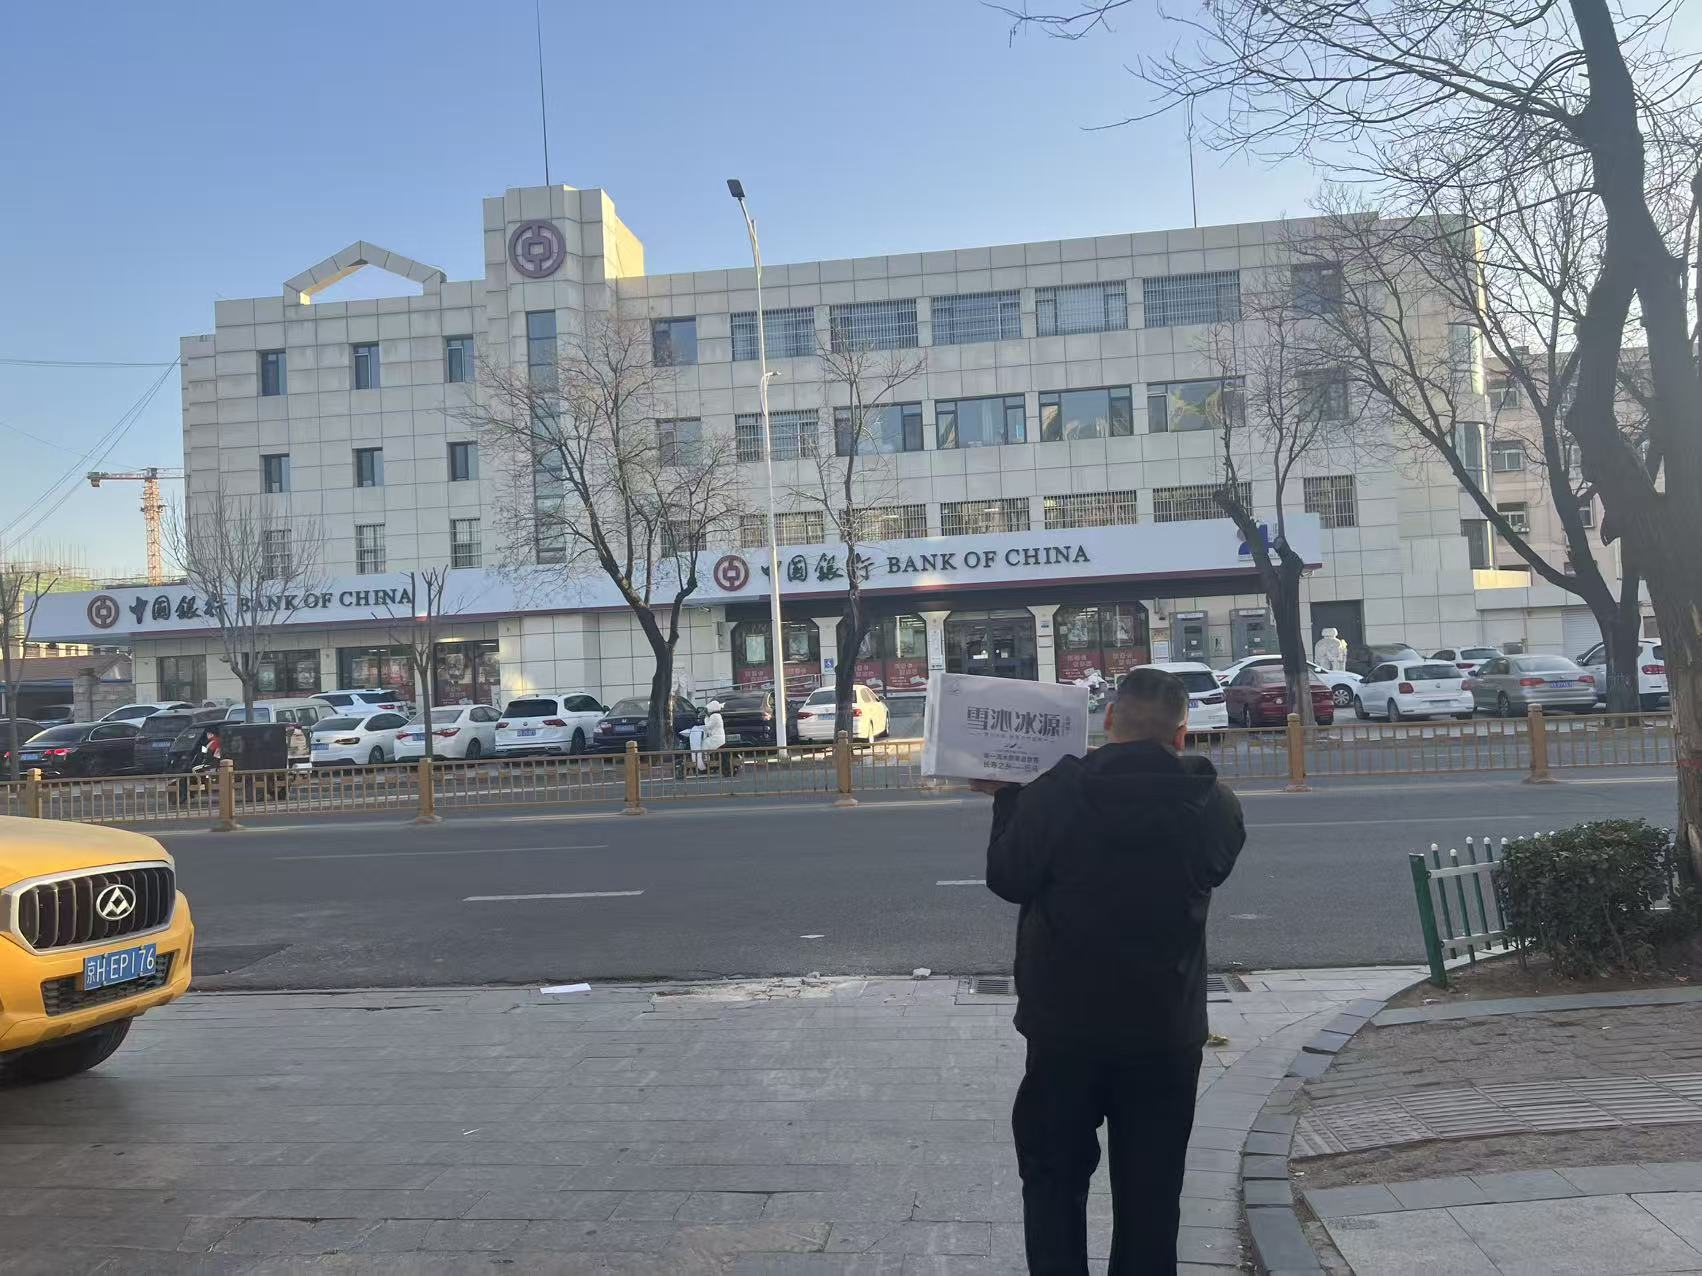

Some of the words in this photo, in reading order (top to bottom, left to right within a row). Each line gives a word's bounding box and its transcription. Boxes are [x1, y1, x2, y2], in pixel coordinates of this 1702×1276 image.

[887, 552, 956, 574] BANK
[964, 550, 997, 568] OF
[1005, 545, 1090, 566] CHINA
[129, 591, 228, 624] 中国银行
[240, 594, 299, 613] BANK
[304, 592, 334, 608] OF
[339, 588, 413, 607] CHINA
